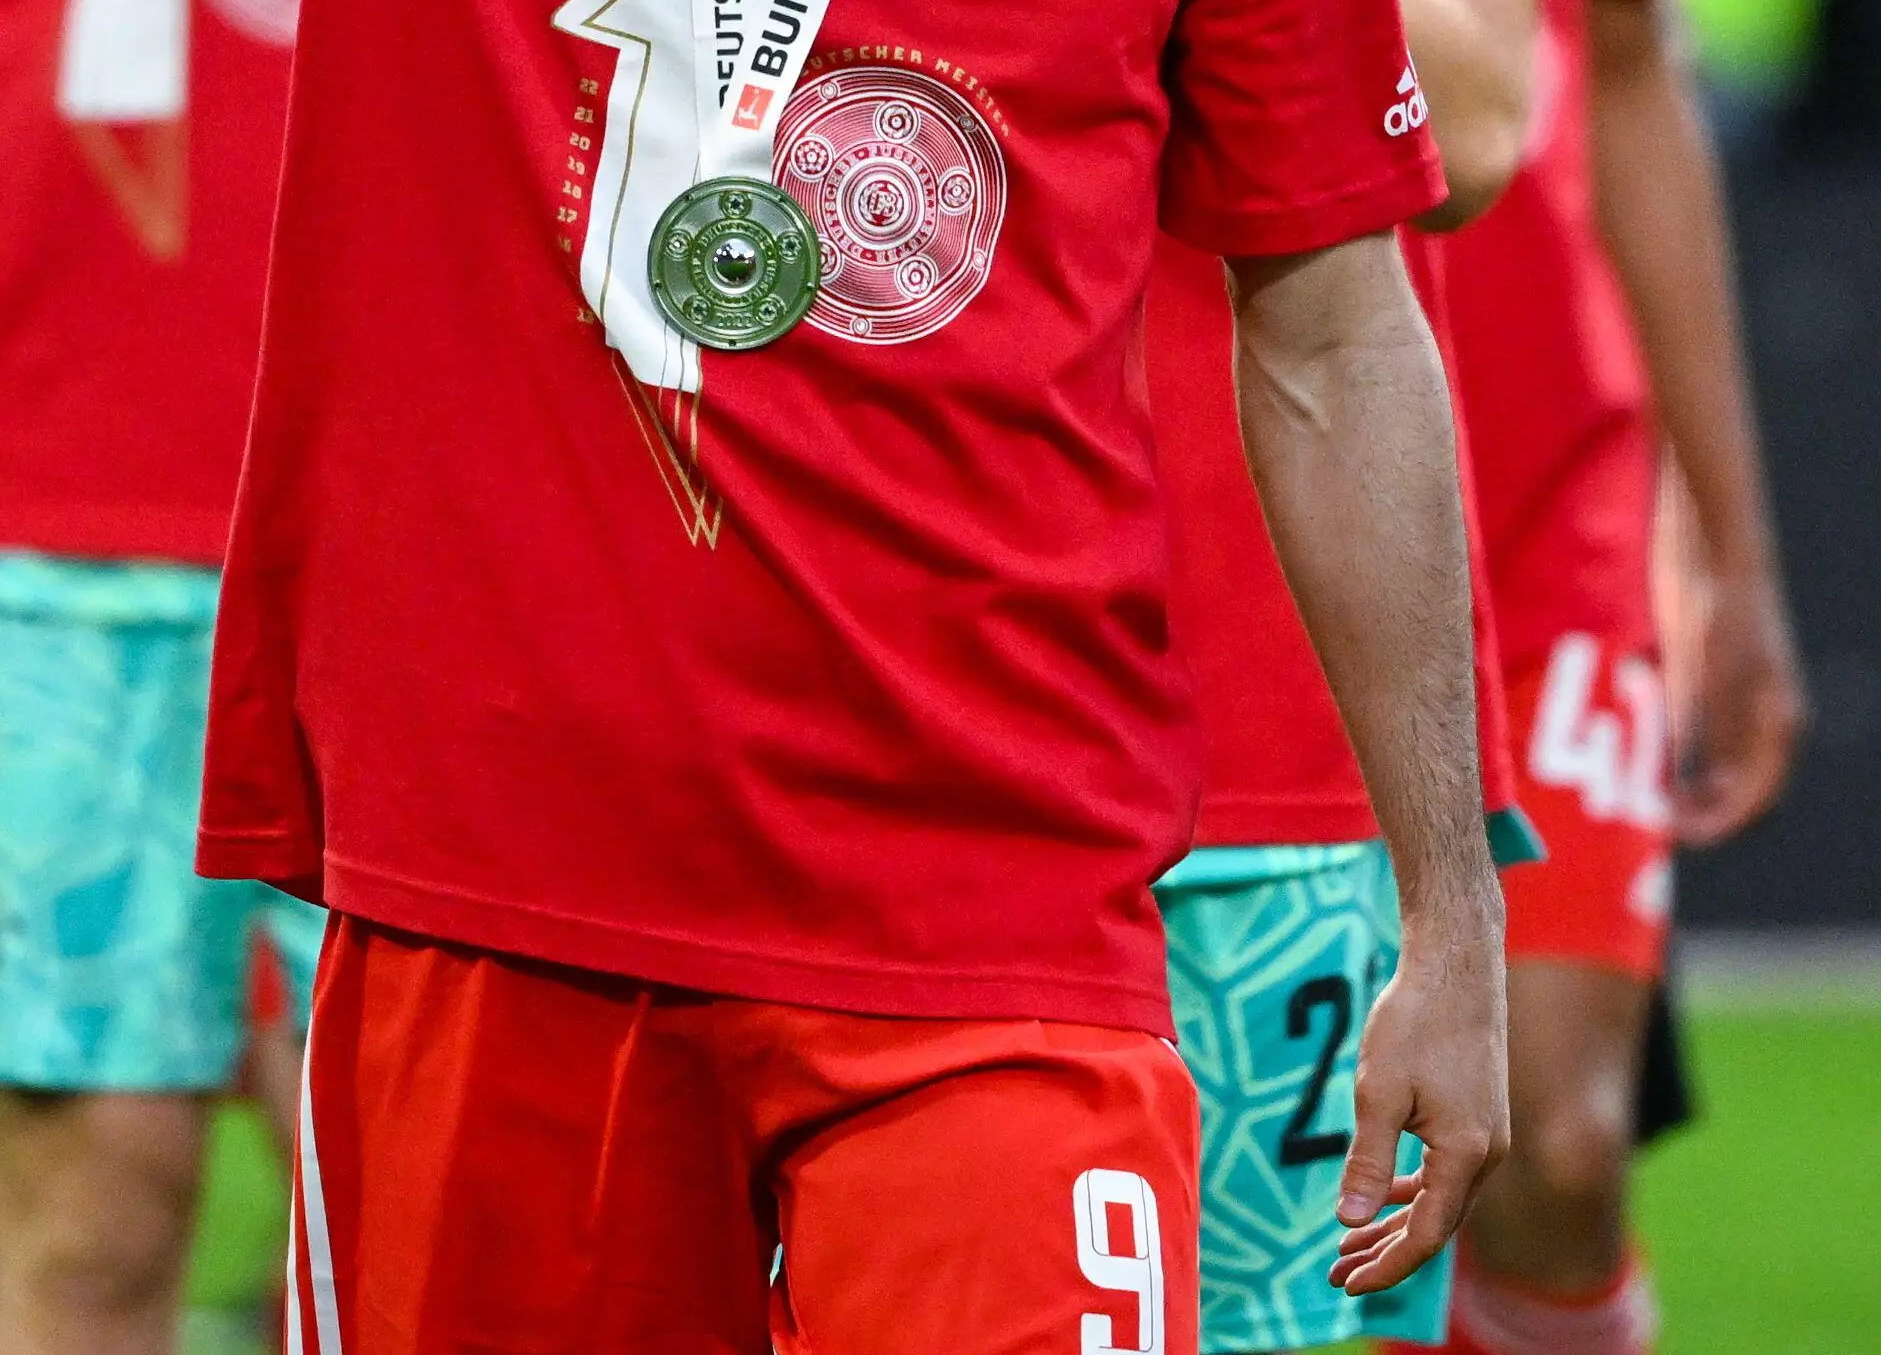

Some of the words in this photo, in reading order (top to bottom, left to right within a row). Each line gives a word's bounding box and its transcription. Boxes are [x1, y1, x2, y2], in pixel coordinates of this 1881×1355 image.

[802, 45, 923, 76] UTSCHER
[574, 106, 594, 123] 21
[570, 132, 591, 151] 20
[1278, 974, 1354, 1167] 2
[1073, 1168, 1165, 1355] 9
